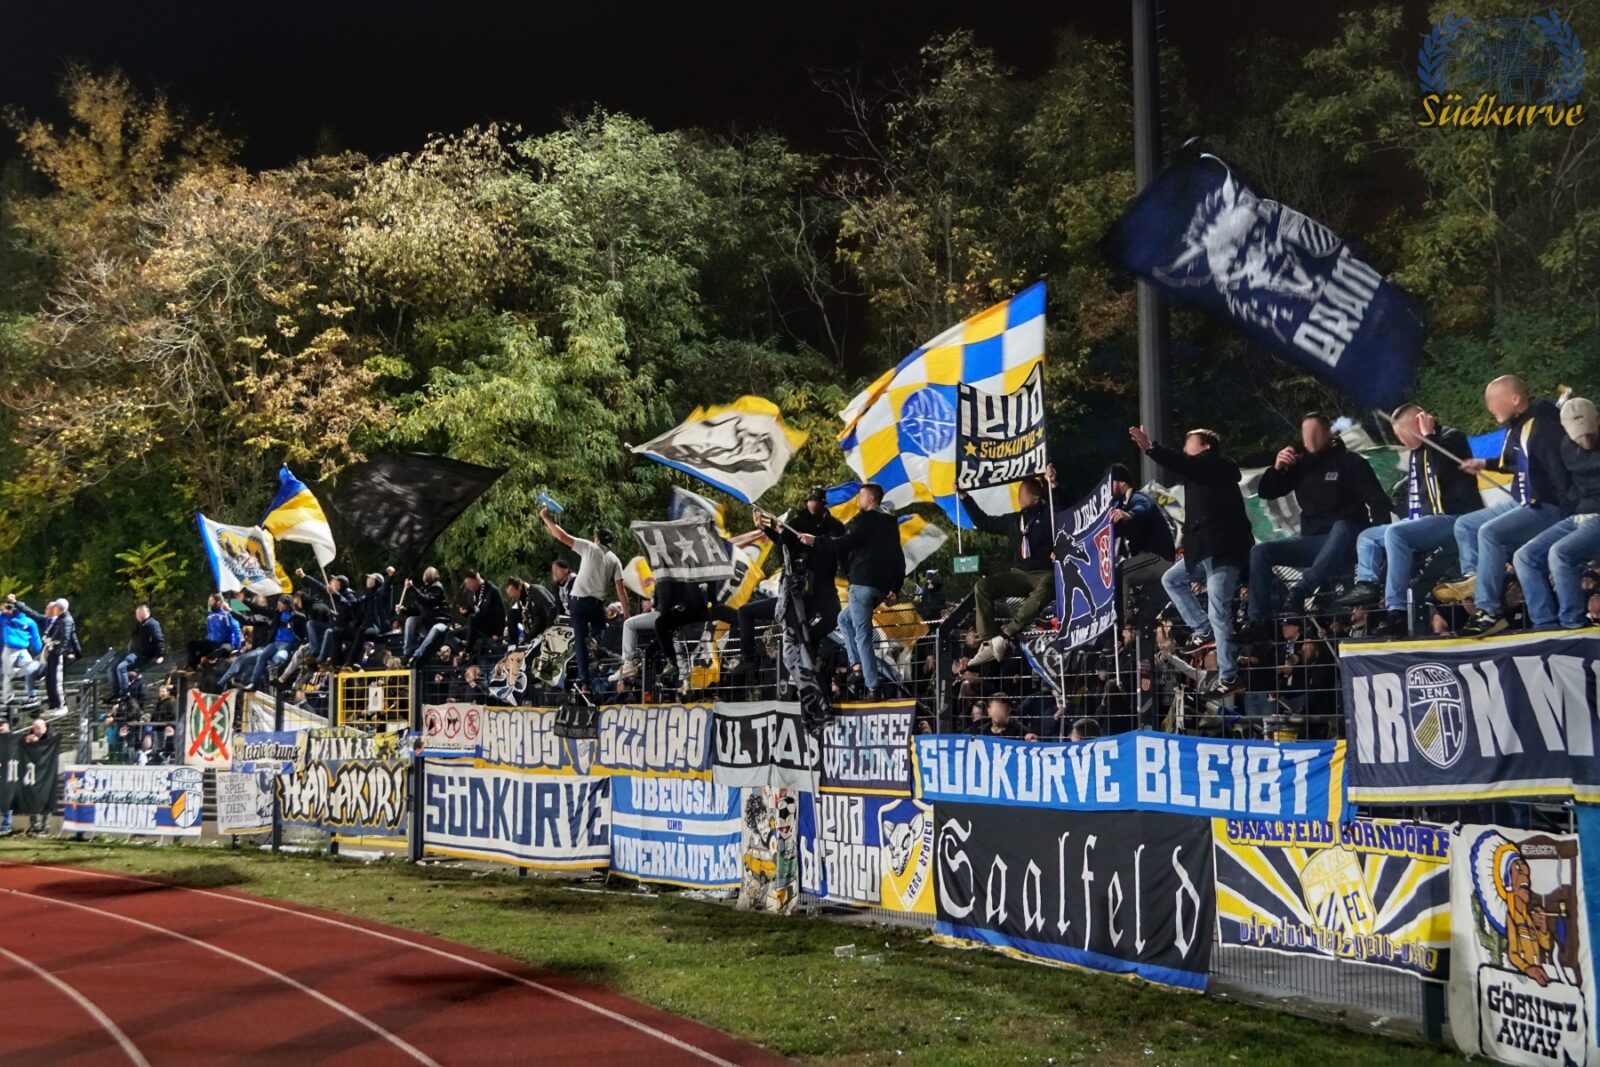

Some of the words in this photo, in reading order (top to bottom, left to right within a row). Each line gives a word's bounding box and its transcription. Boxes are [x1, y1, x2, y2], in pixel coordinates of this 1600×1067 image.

[1419, 686, 1452, 700] JENA
[824, 713, 911, 747] REFUGEES
[1439, 703, 1463, 758] FC
[823, 747, 909, 782] WELCOME
[919, 738, 1120, 803] SÜDKURVE
[1136, 736, 1321, 816] BLEIBT
[95, 802, 157, 830] KANONE
[426, 772, 610, 848] SÜDKURVE
[667, 819, 683, 831] UND
[1227, 820, 1334, 844] SAALFELD
[937, 817, 1201, 961] Saalfeld
[1343, 891, 1368, 926] FC
[1496, 1017, 1562, 1059] AWAY
